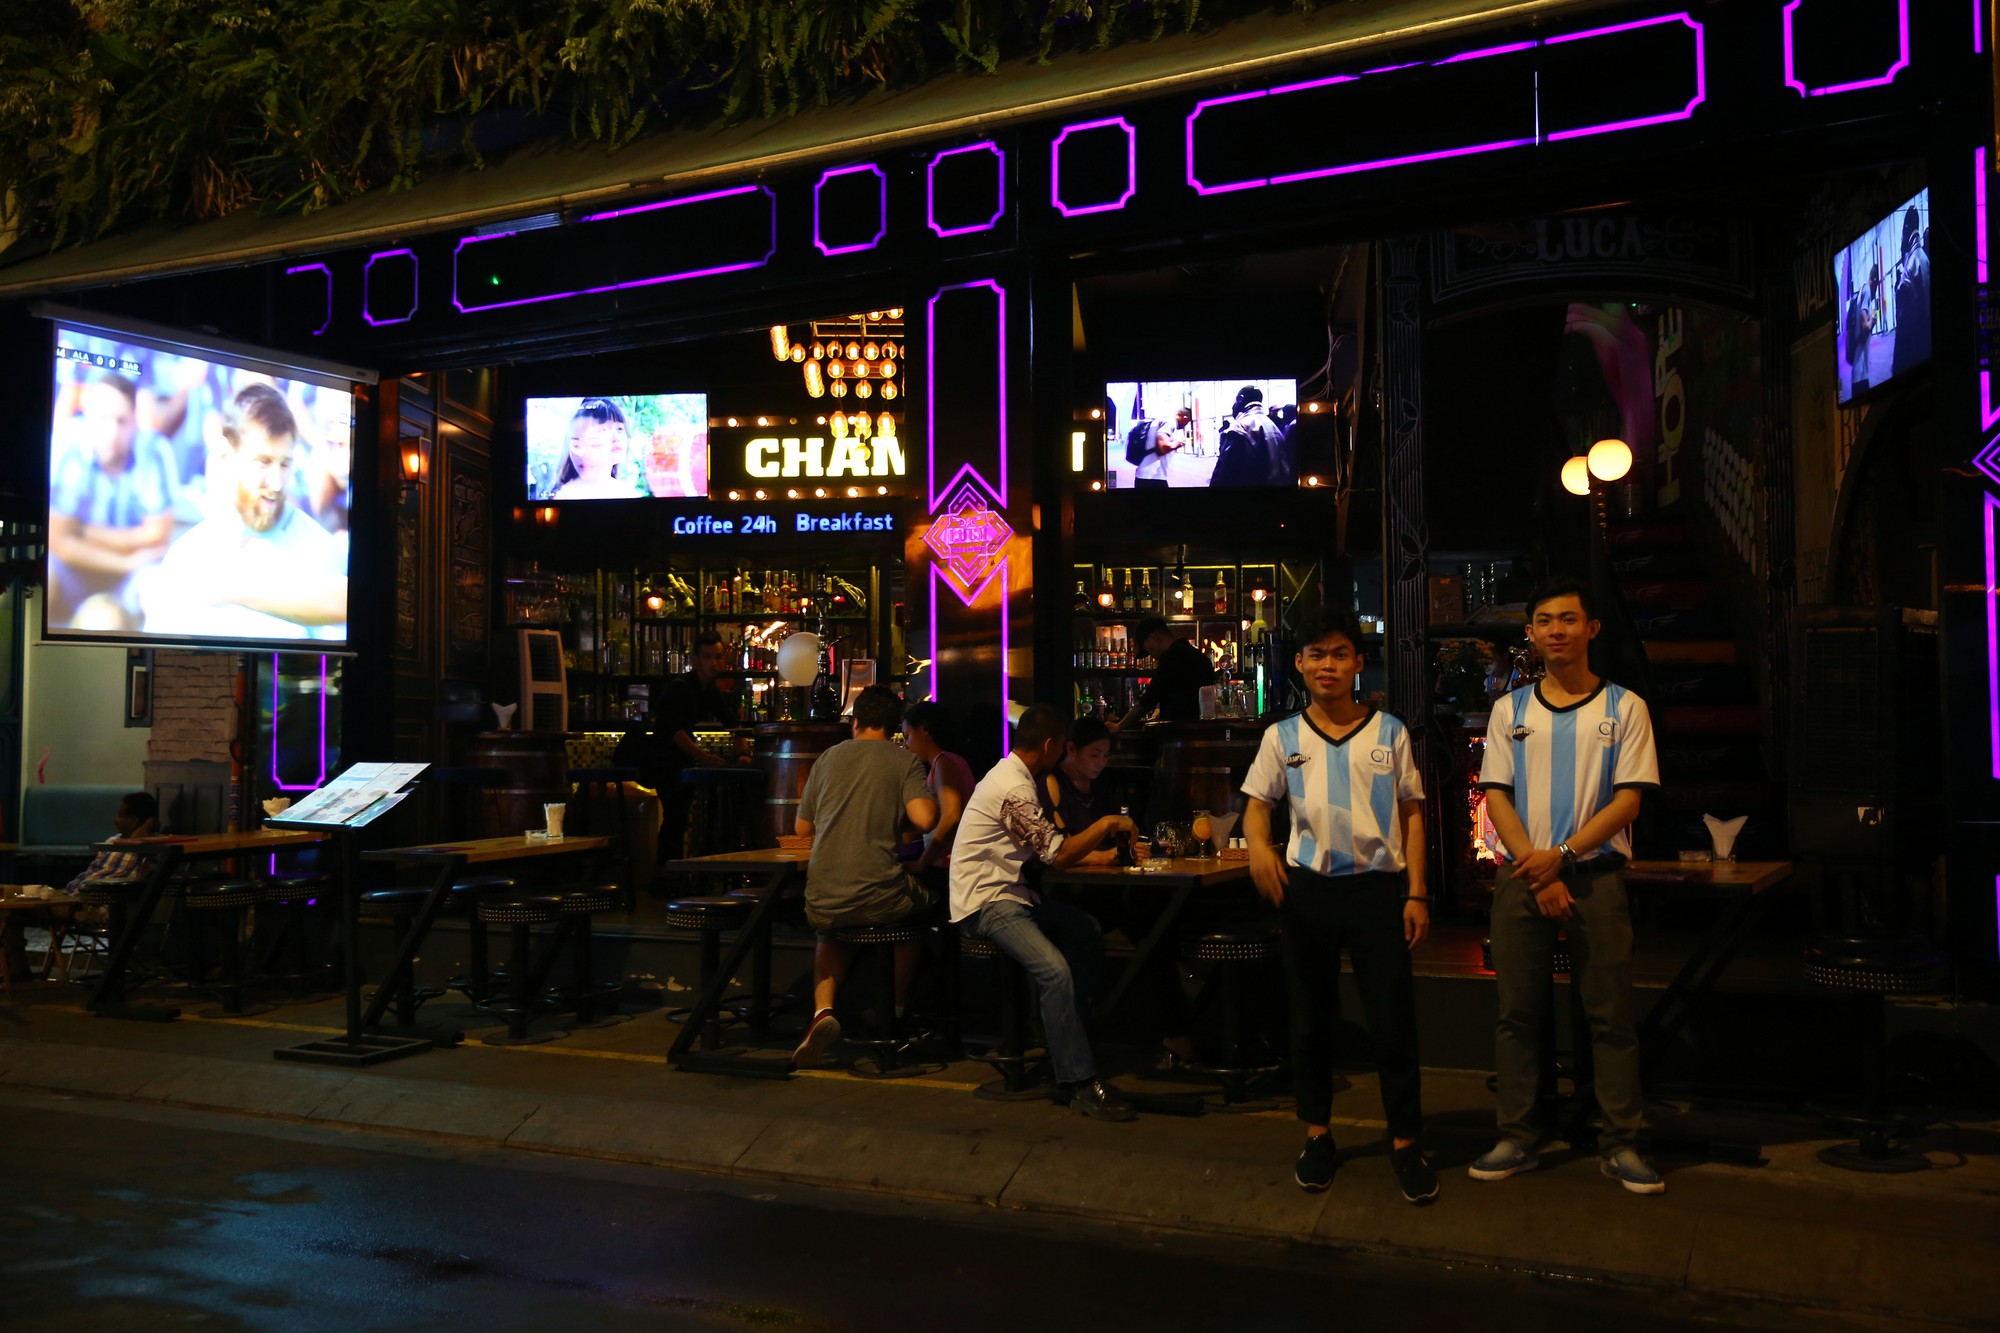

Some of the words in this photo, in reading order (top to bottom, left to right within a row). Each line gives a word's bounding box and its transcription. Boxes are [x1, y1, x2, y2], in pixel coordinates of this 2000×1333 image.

[1532, 215, 1645, 261] LUCA
[73, 350, 90, 361] ALA
[97, 355, 104, 366] 0
[109, 358, 116, 369] 0
[122, 360, 139, 371] BAR
[673, 516, 733, 535] Coffee
[740, 514, 777, 534] 24h
[796, 512, 893, 532] Breakfast
